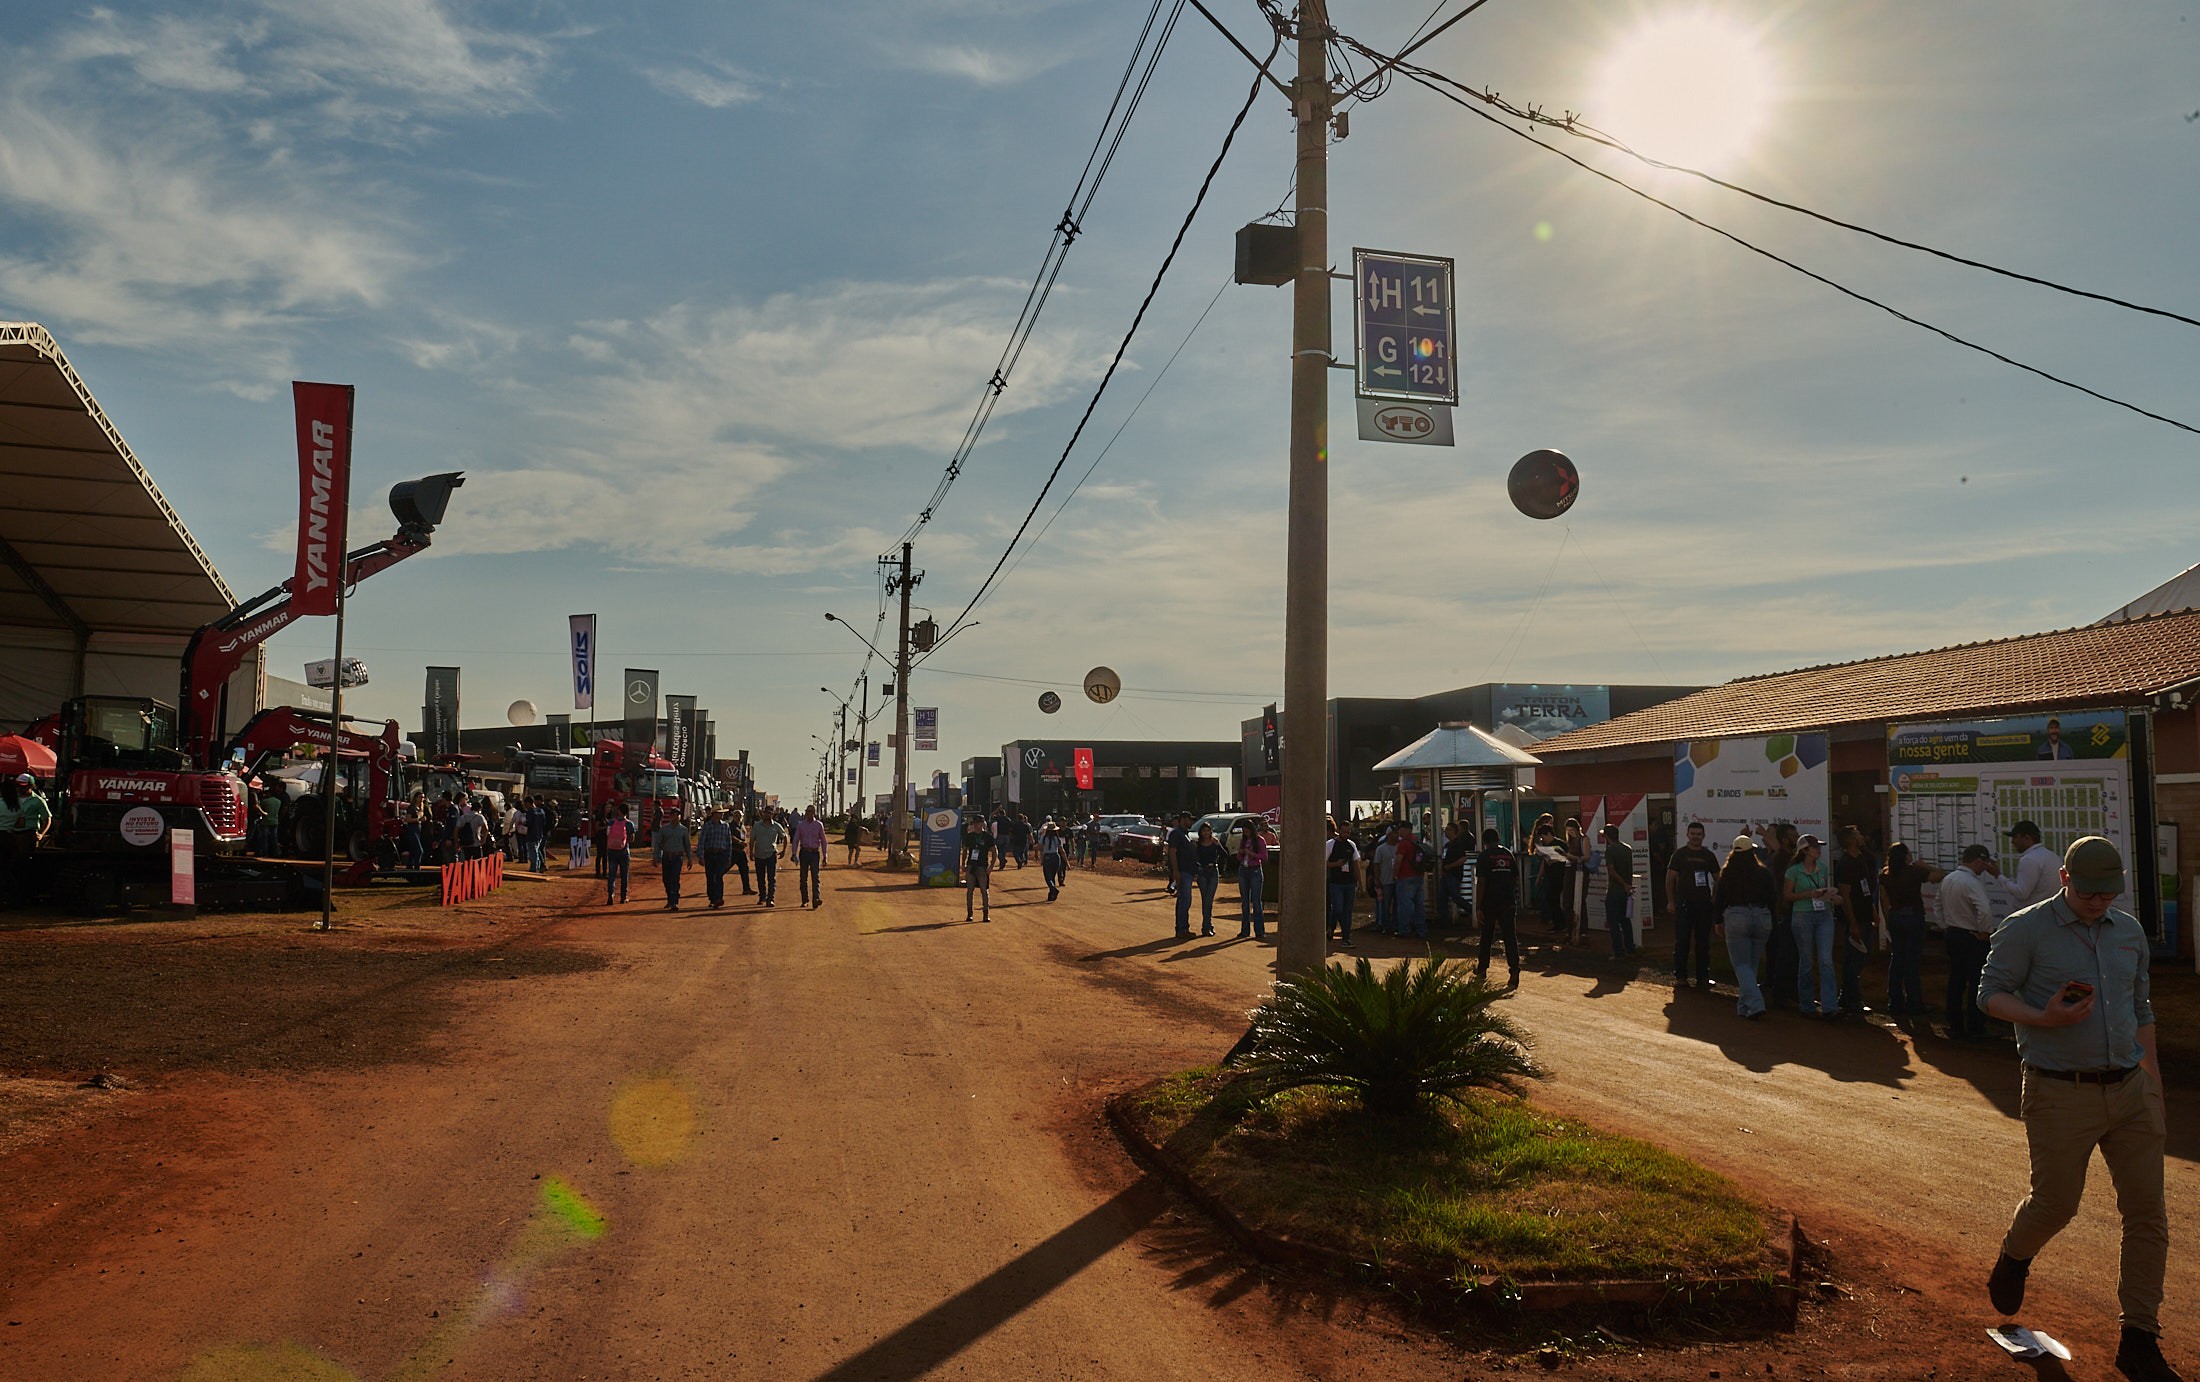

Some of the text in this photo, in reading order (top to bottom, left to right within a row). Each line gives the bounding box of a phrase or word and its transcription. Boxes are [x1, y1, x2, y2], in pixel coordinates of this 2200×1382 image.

[1382, 277, 1402, 309] H
[1410, 275, 1438, 303] 11
[1378, 336, 1398, 363] G
[1409, 336, 1434, 357] 10
[1409, 363, 1434, 384] 12
[1381, 414, 1431, 432] YTO
[306, 419, 334, 594] YANMAR
[239, 612, 289, 643] YANMAR
[1521, 696, 1580, 704] TRITON
[1515, 704, 1587, 718] TERRA
[1903, 735, 1919, 746] força
[1919, 735, 1928, 743] do
[1929, 736, 1944, 746] agro
[1959, 733, 1968, 741] da
[1899, 743, 1969, 761] nossa gente
[98, 779, 167, 791] YANMAR
[1723, 789, 1741, 798] BNDES
[1662, 811, 1673, 825] 08
[441, 851, 504, 907] YANMAR
